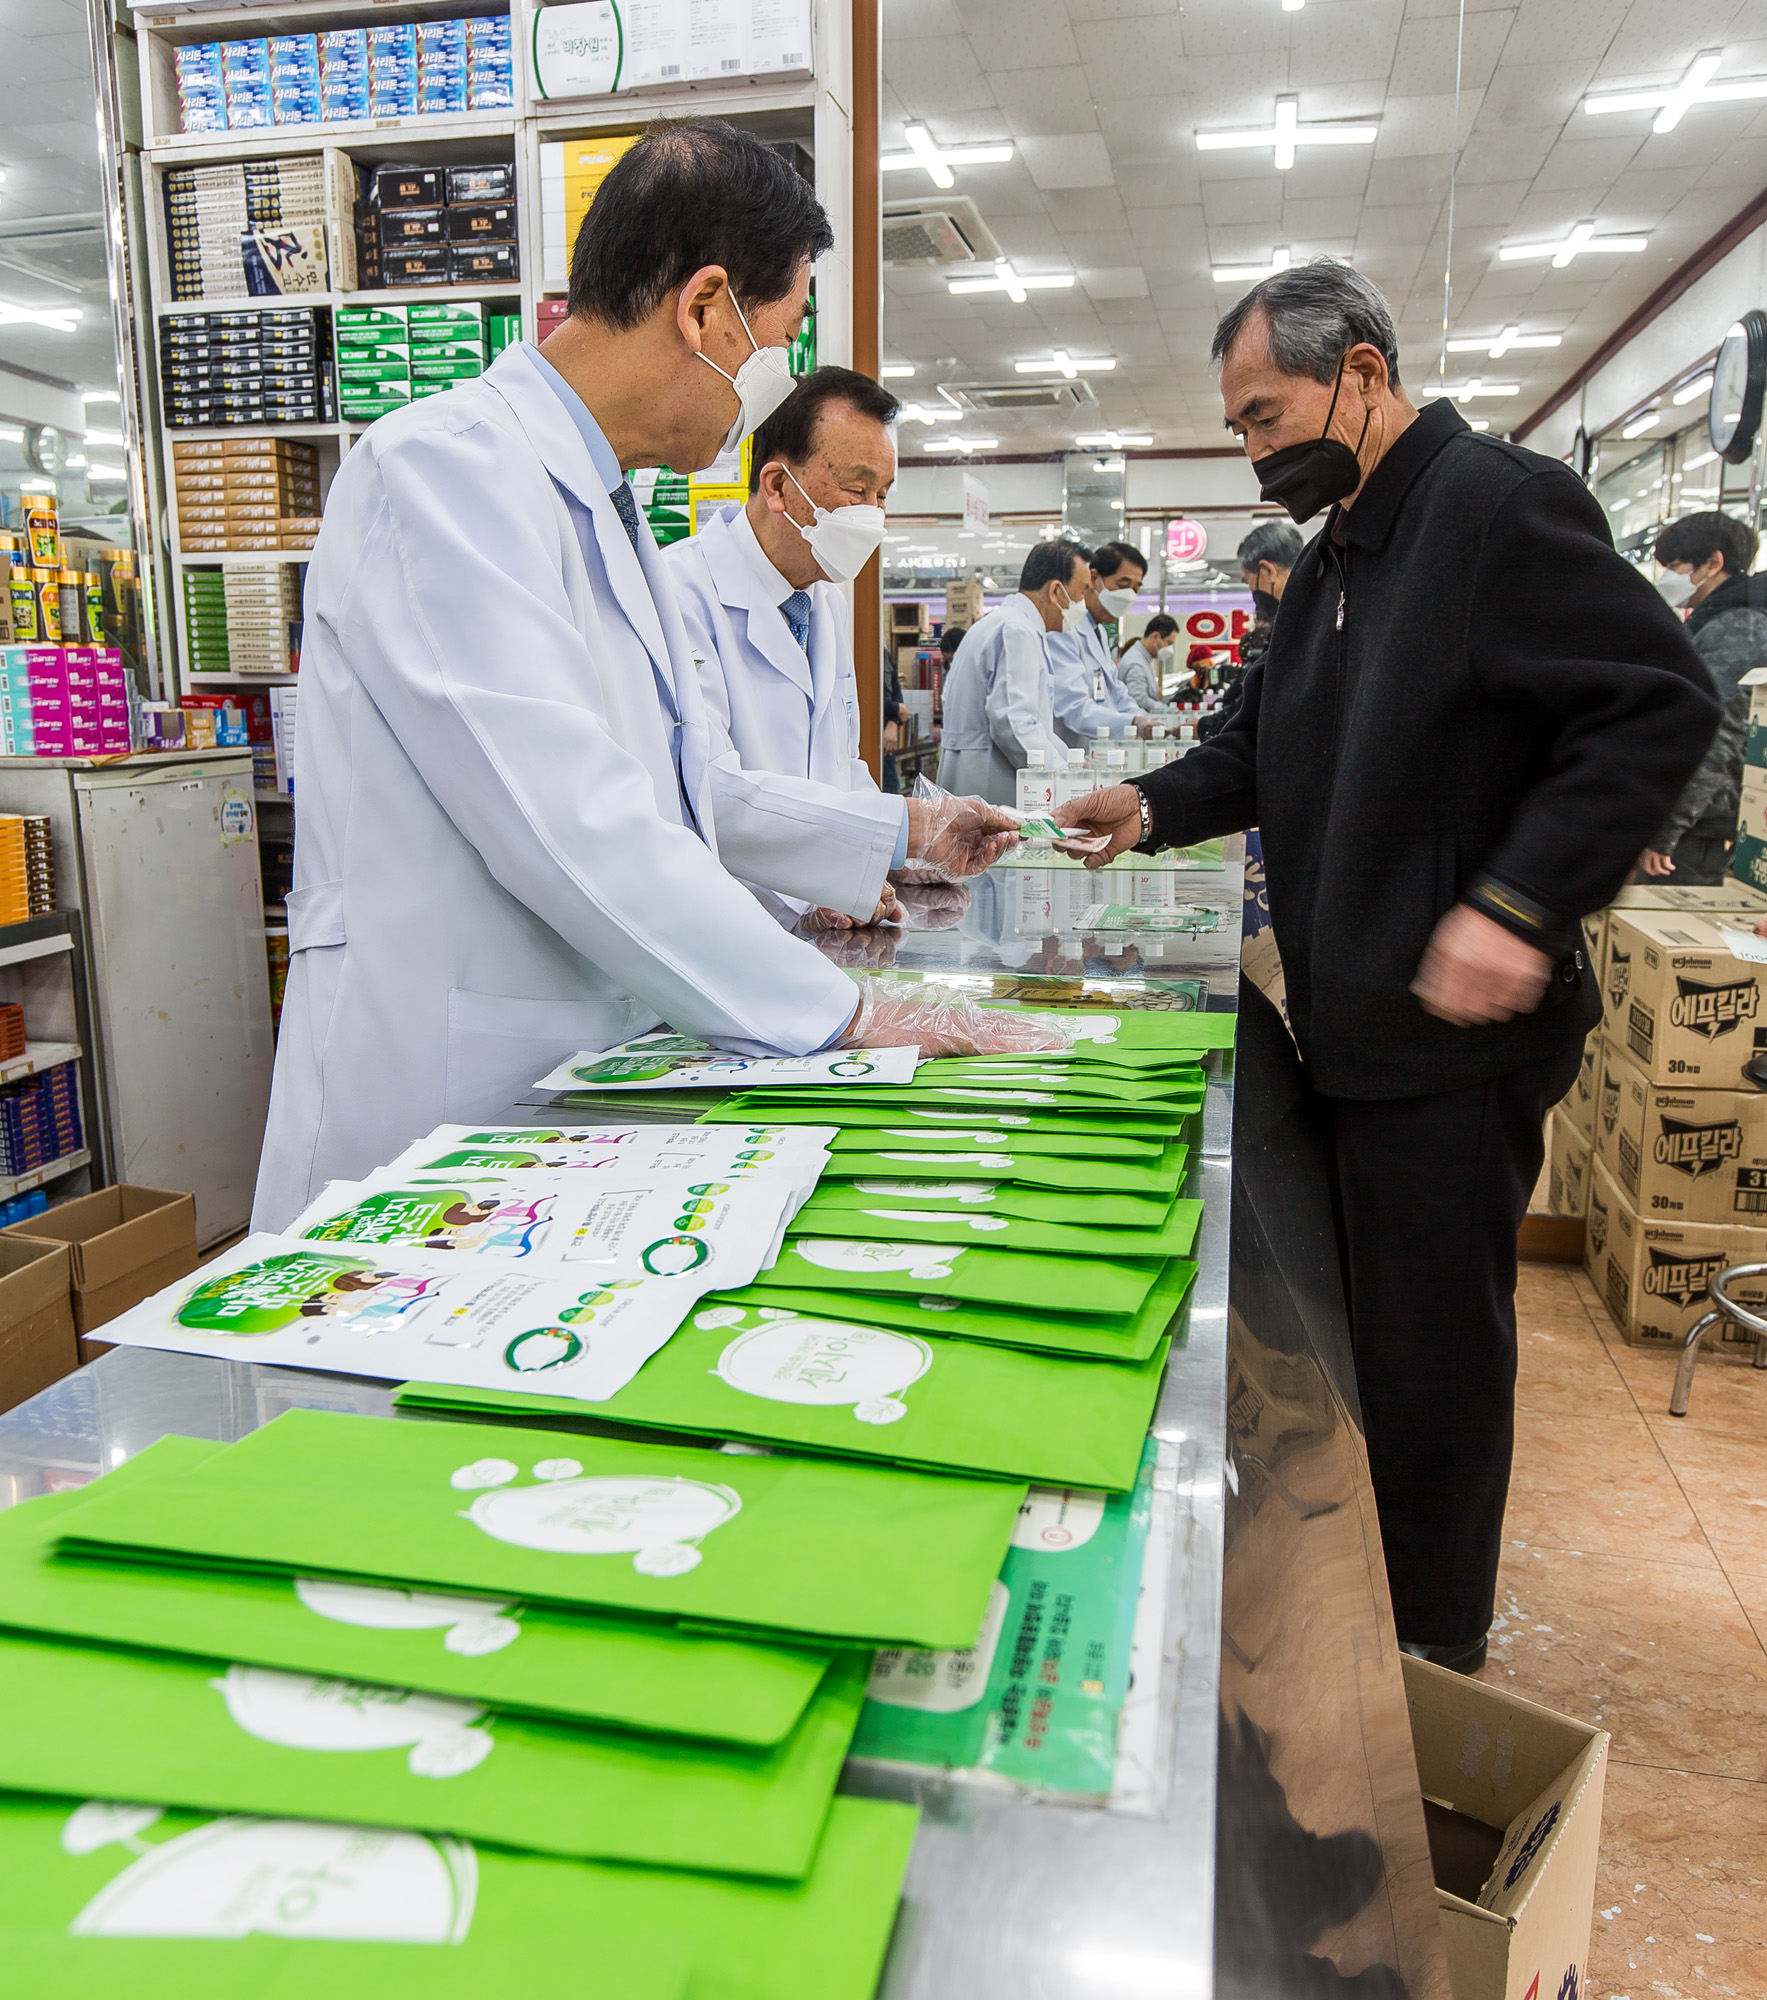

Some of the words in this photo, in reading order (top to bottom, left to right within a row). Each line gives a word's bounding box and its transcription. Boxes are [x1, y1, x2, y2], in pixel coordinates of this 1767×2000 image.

[562, 37, 599, 56] 비장원
[1670, 984, 1760, 1028] 에프킬라
[1653, 1126, 1743, 1165] 에프킬라
[355, 1198, 420, 1243] 세먼지
[216, 1259, 325, 1317] 미세먼지
[258, 1266, 343, 1310] 마스크
[797, 1336, 866, 1389] 센시아
